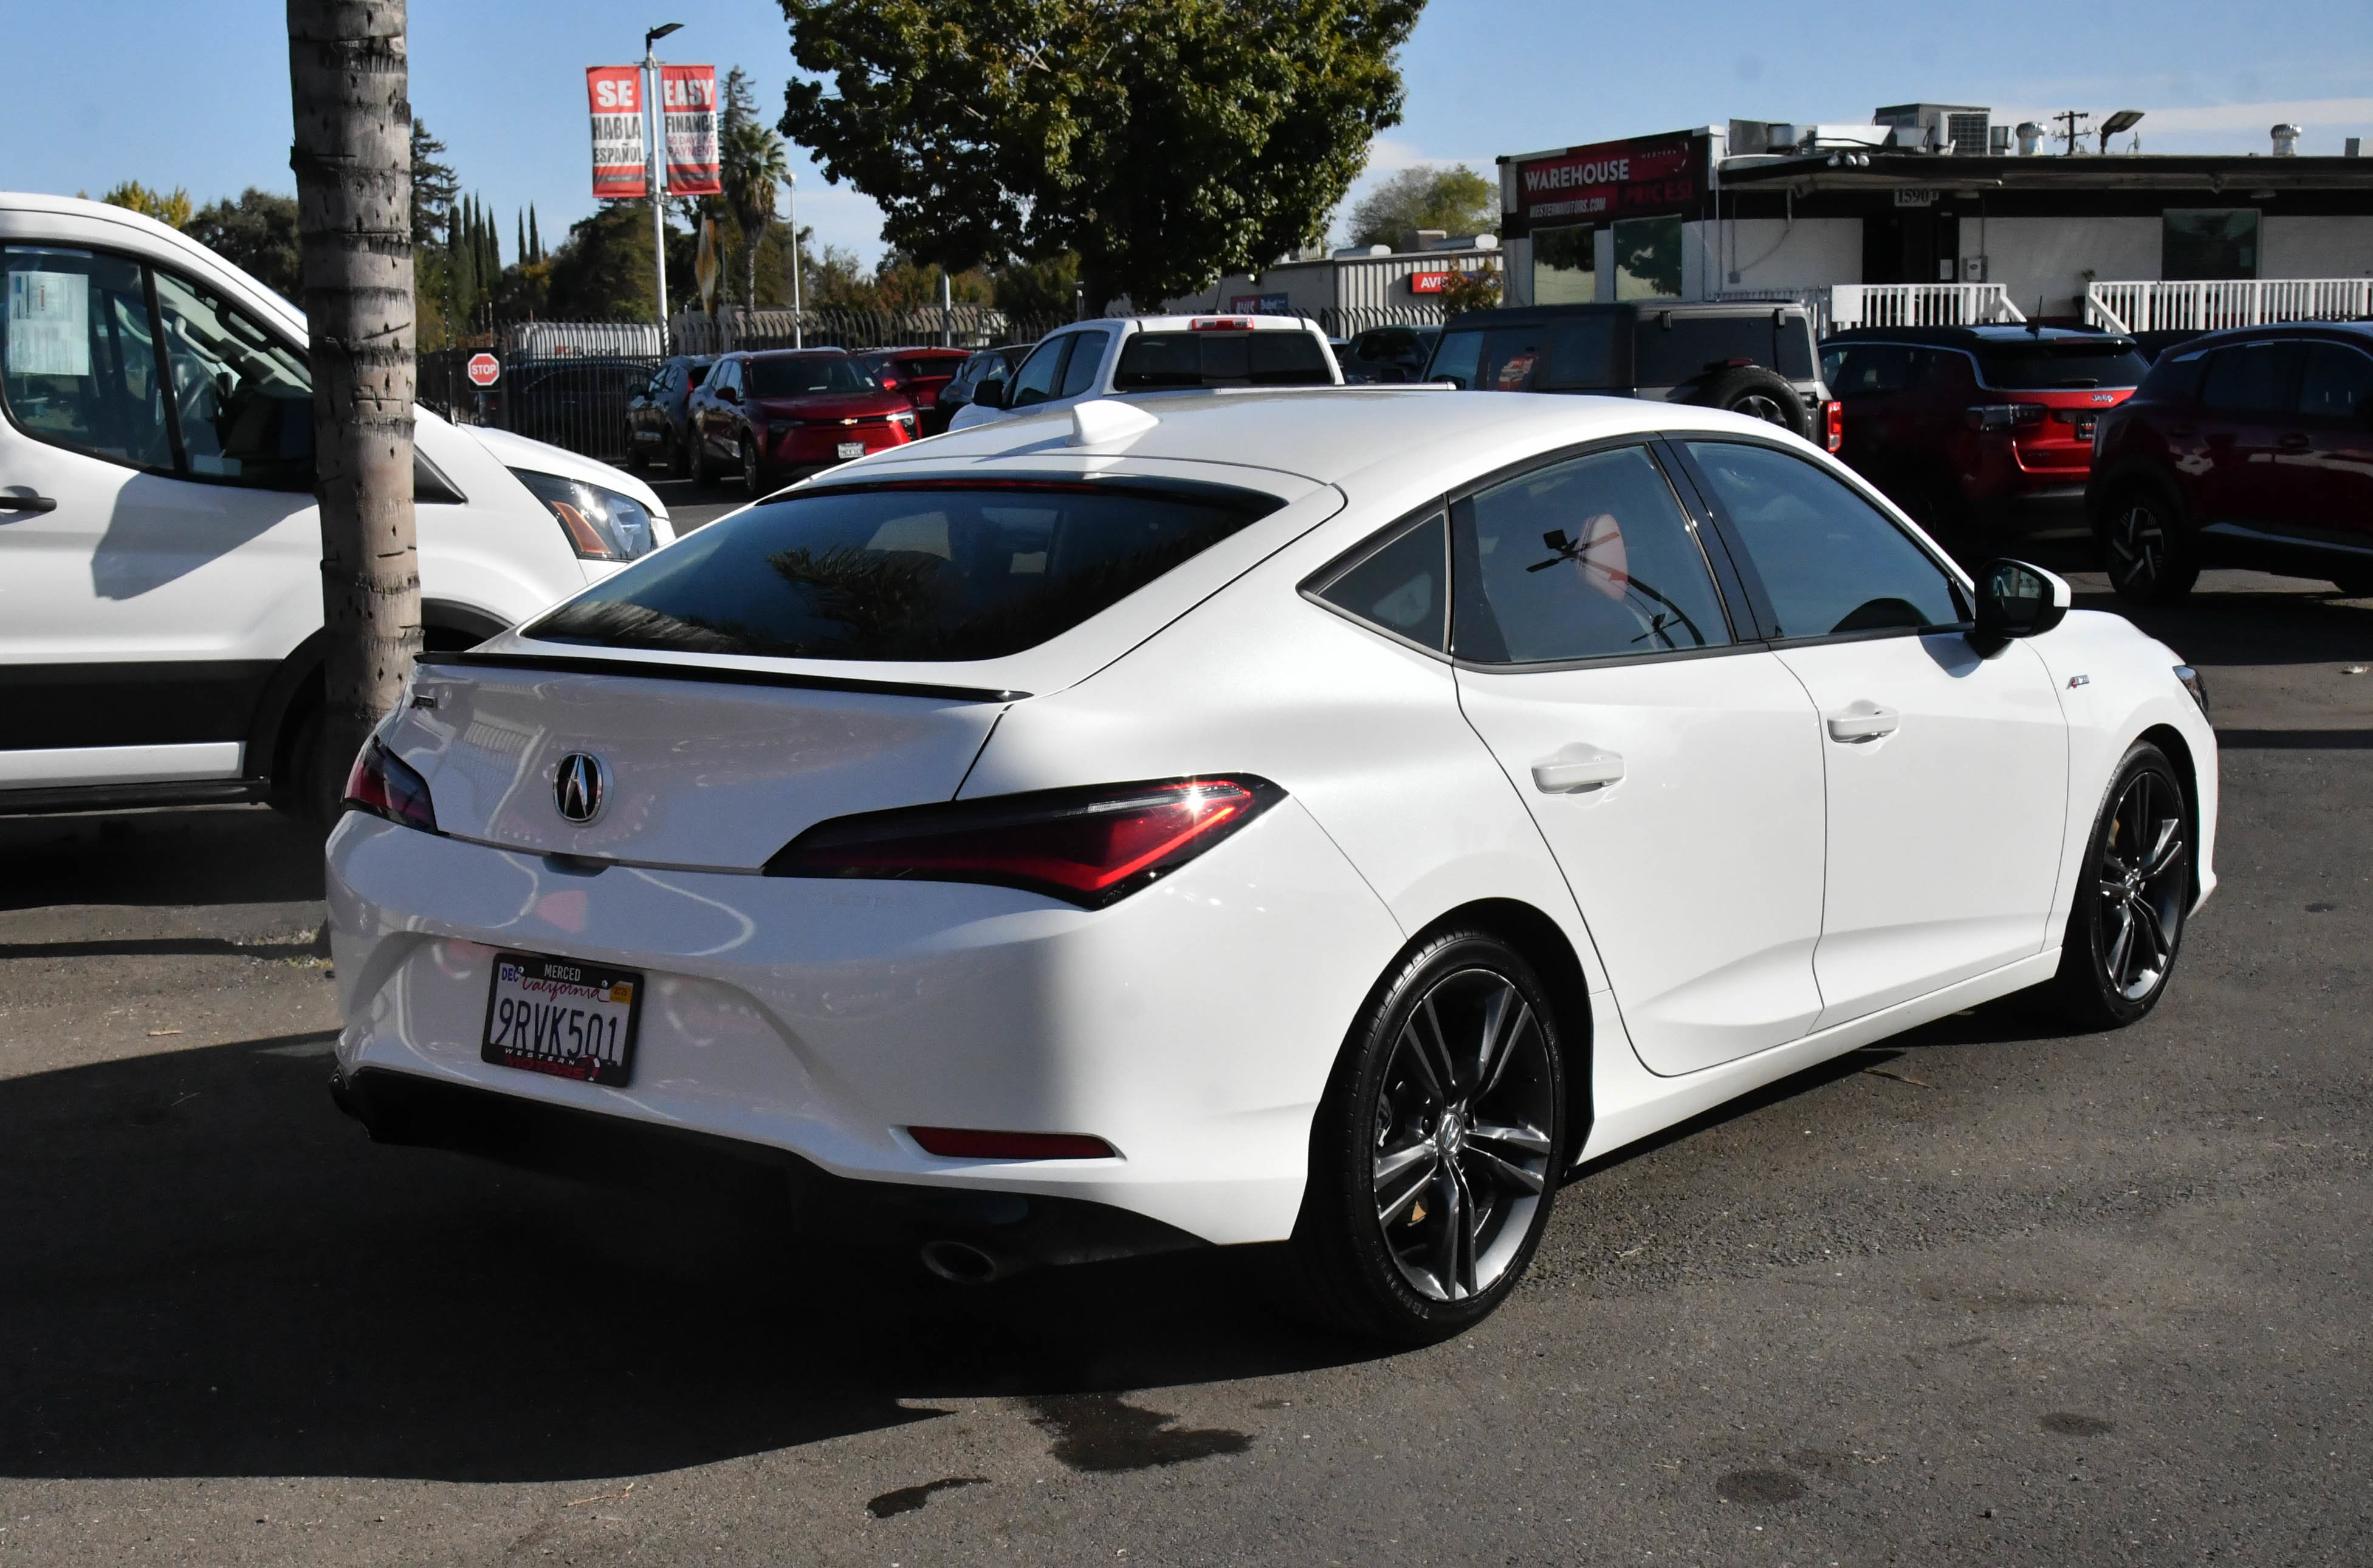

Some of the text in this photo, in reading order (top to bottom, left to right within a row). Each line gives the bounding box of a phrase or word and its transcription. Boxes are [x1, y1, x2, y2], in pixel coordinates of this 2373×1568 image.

[596, 80, 634, 108] SE
[663, 79, 714, 106] EASY
[592, 116, 642, 140] HABLA
[665, 114, 715, 133] FINANCE
[679, 135, 701, 145] DAYS
[593, 142, 643, 163] ESPAÑOL
[1525, 158, 1630, 192] WAREHOUSE
[1897, 188, 1929, 204] 1590
[472, 364, 496, 375] STOP
[2092, 394, 2114, 403] Jeep
[501, 967, 520, 982] DEC
[544, 964, 581, 982] MERCED
[522, 976, 610, 1003] California
[495, 998, 617, 1061] 9RVK501
[505, 1048, 575, 1066] WESTERN
[505, 1056, 586, 1080] MOTORS
